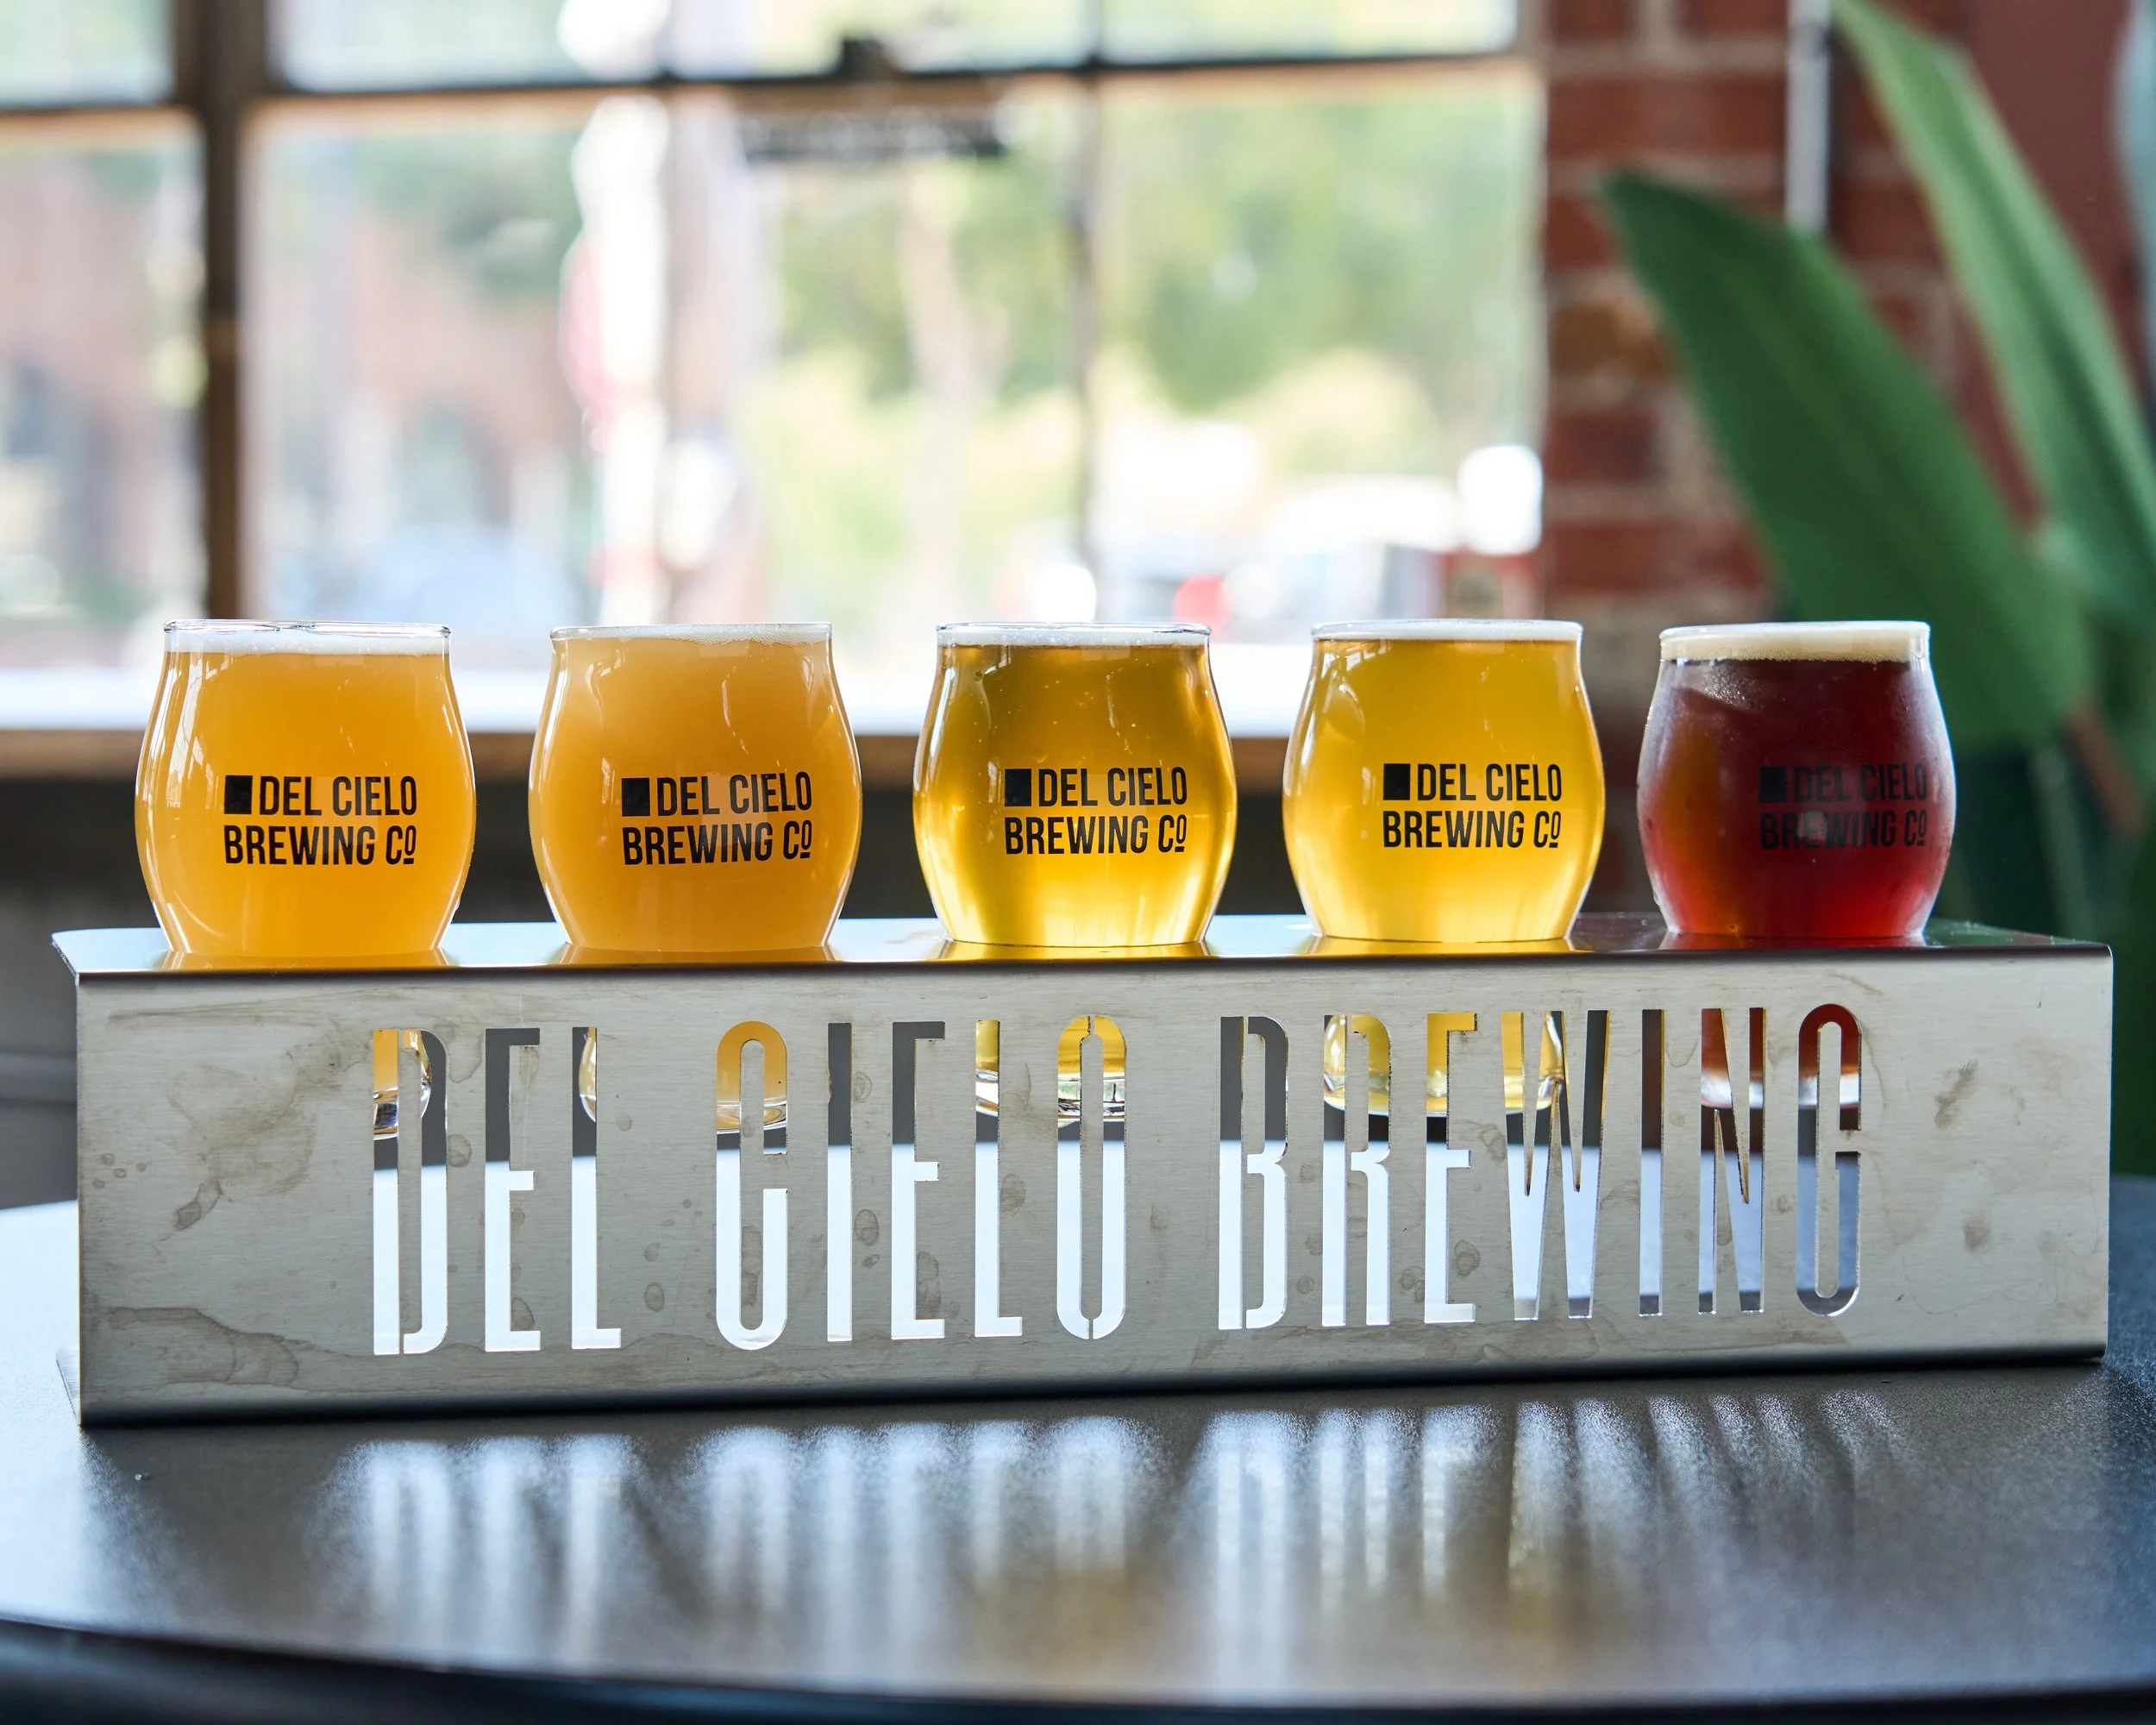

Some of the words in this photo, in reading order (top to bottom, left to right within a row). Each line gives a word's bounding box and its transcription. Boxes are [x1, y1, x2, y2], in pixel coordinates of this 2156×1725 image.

[260, 775, 323, 816] DEL
[333, 775, 417, 816] CIELO
[656, 776, 720, 817] DEL
[730, 771, 812, 814] CIELO
[1038, 768, 1098, 806] DEL
[1107, 767, 1187, 806] CIELO
[1417, 763, 1476, 801] DEL
[1485, 763, 1562, 801] CIELO
[1794, 765, 1853, 803] DEL
[1860, 762, 1927, 801] CIELO
[223, 825, 375, 865] BREWING
[622, 822, 773, 865] BREWING
[1005, 815, 1149, 854] BREWING
[1383, 811, 1524, 848] BREWING
[373, 1026, 621, 1356] DEL
[716, 1015, 1126, 1351] CIELO
[1218, 1003, 1862, 1331] BREWING
